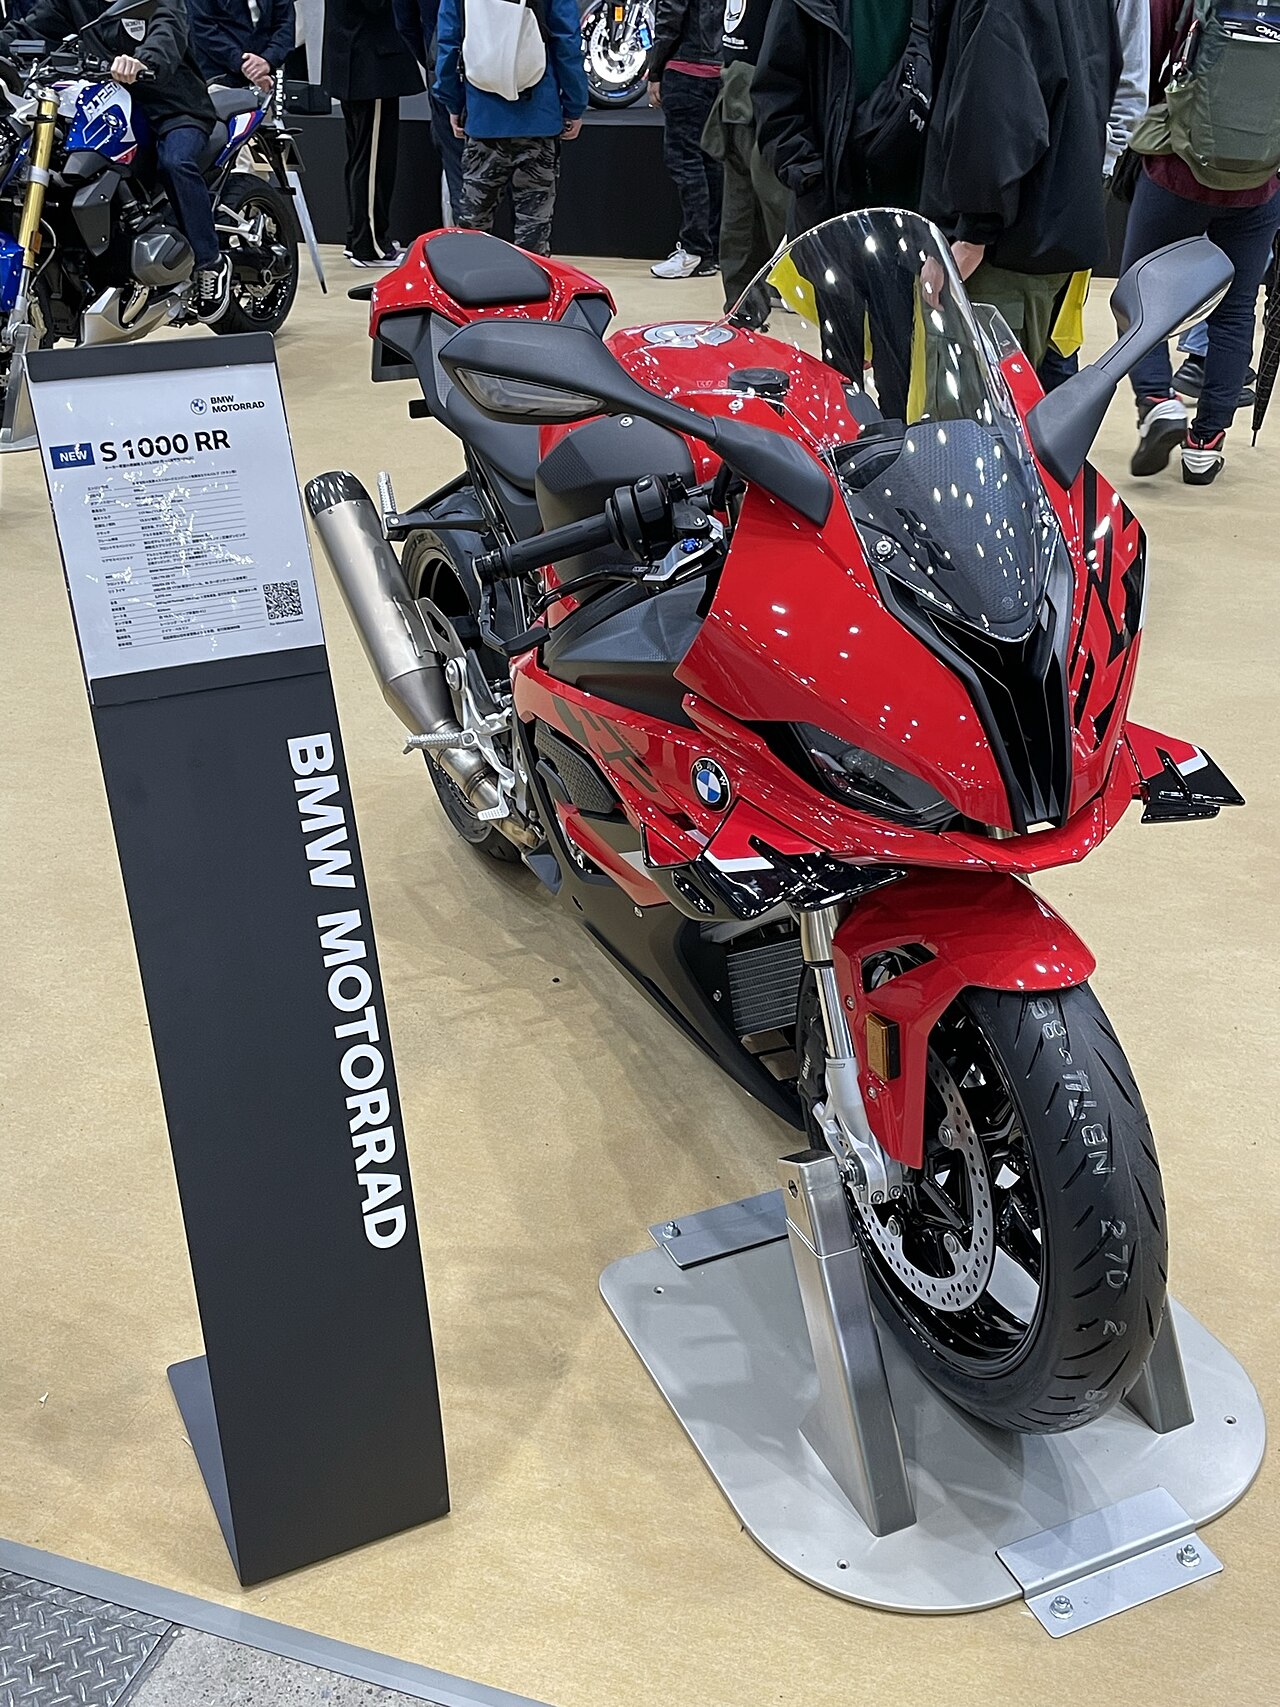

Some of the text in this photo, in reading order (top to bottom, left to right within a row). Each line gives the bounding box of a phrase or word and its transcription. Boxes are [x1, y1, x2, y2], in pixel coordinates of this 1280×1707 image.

[210, 394, 235, 405] BMW
[211, 400, 265, 414] MOTORRAD
[99, 429, 231, 463] S 1000 RR
[59, 448, 88, 463] NEW
[286, 731, 407, 1250] BMW MOTORRAD
